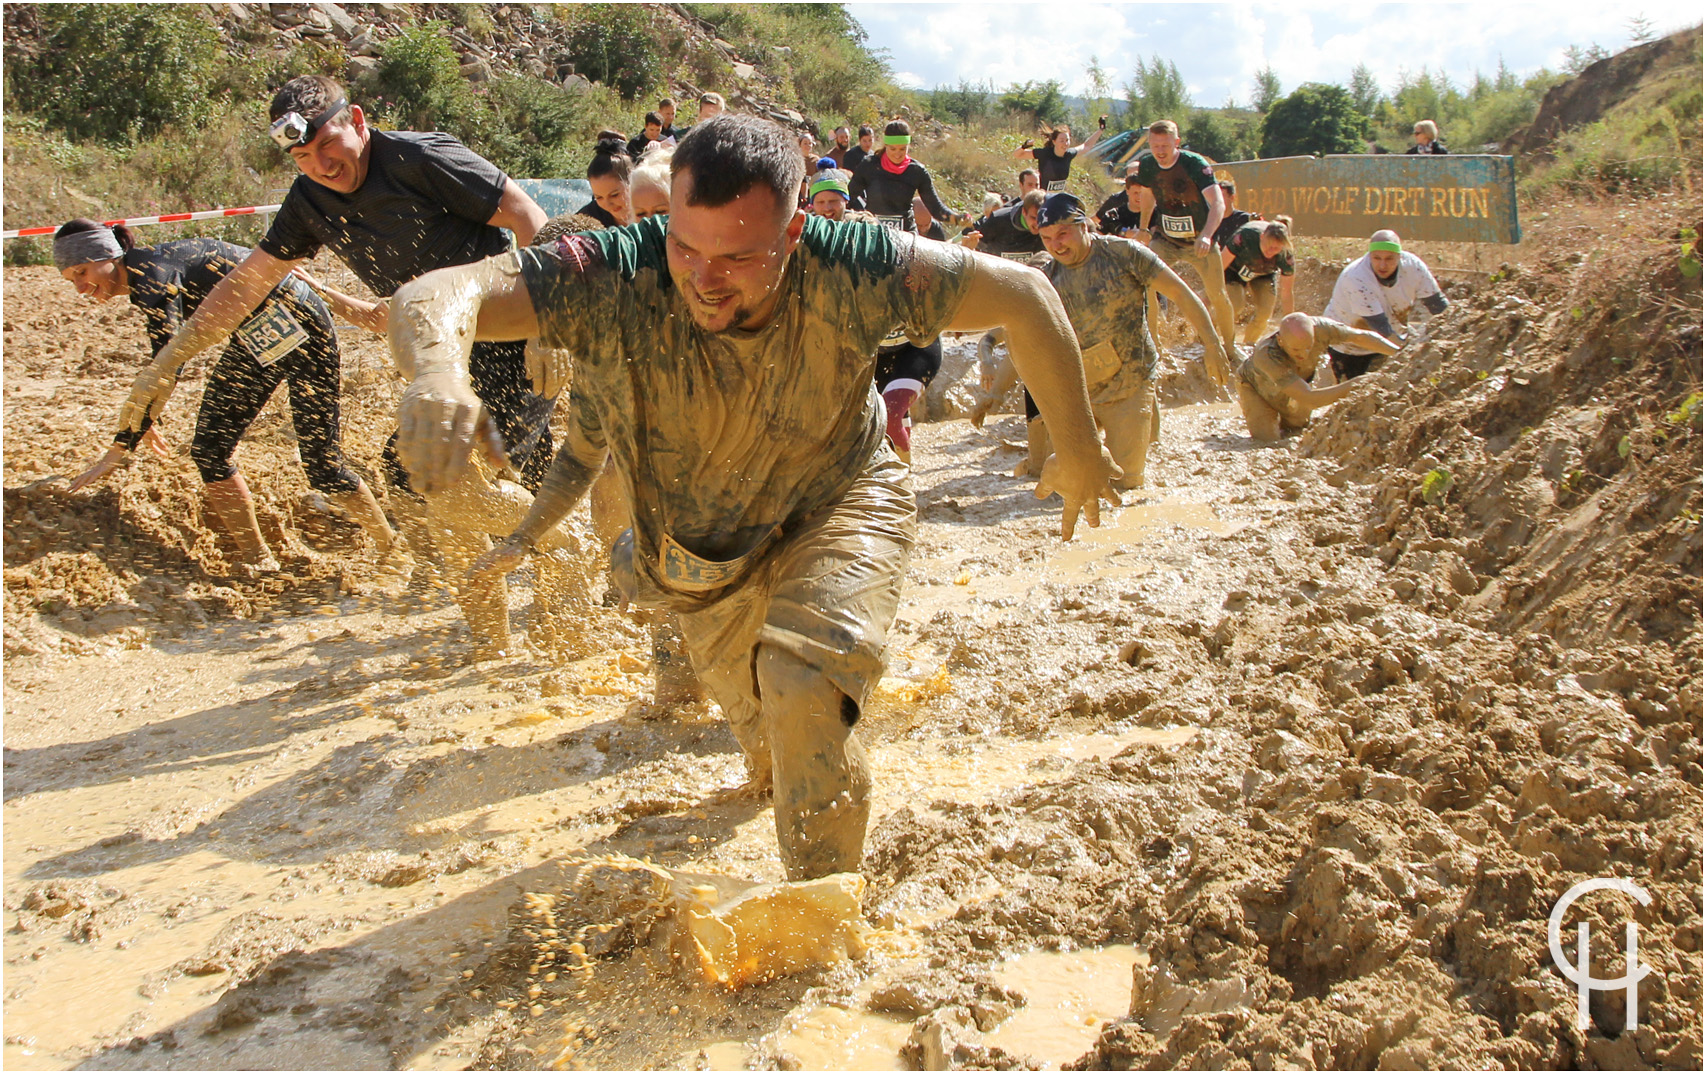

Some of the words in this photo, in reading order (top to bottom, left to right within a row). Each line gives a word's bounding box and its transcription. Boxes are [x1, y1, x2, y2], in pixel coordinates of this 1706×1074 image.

[1246, 188, 1286, 214] BAD
[1291, 186, 1359, 215] WOLF
[1363, 187, 1425, 216] DIRT
[1430, 187, 1490, 218] RUN
[1165, 220, 1190, 231] 1571
